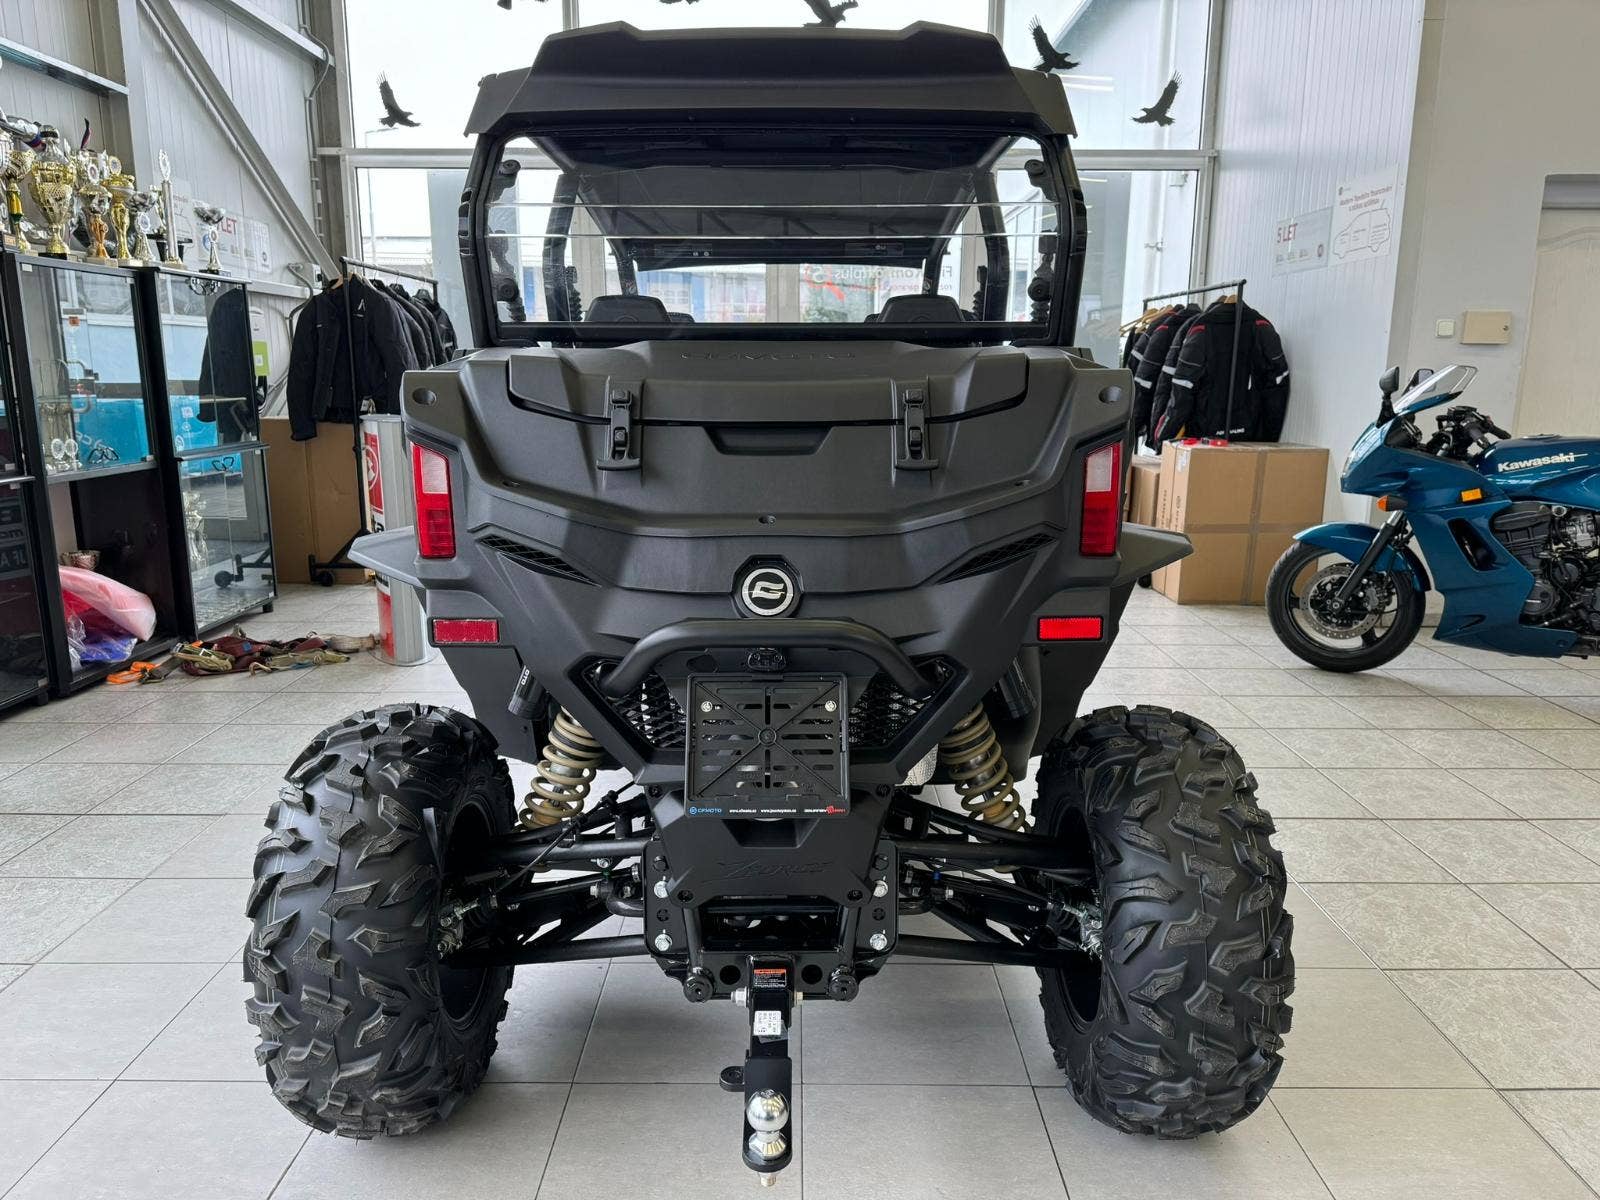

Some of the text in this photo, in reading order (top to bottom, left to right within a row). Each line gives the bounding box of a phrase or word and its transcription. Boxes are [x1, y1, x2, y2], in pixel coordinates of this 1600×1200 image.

[1282, 222, 1299, 243] LET
[1216, 427, 1245, 435] ADRALINE
[1497, 453, 1575, 473] Kawasaki
